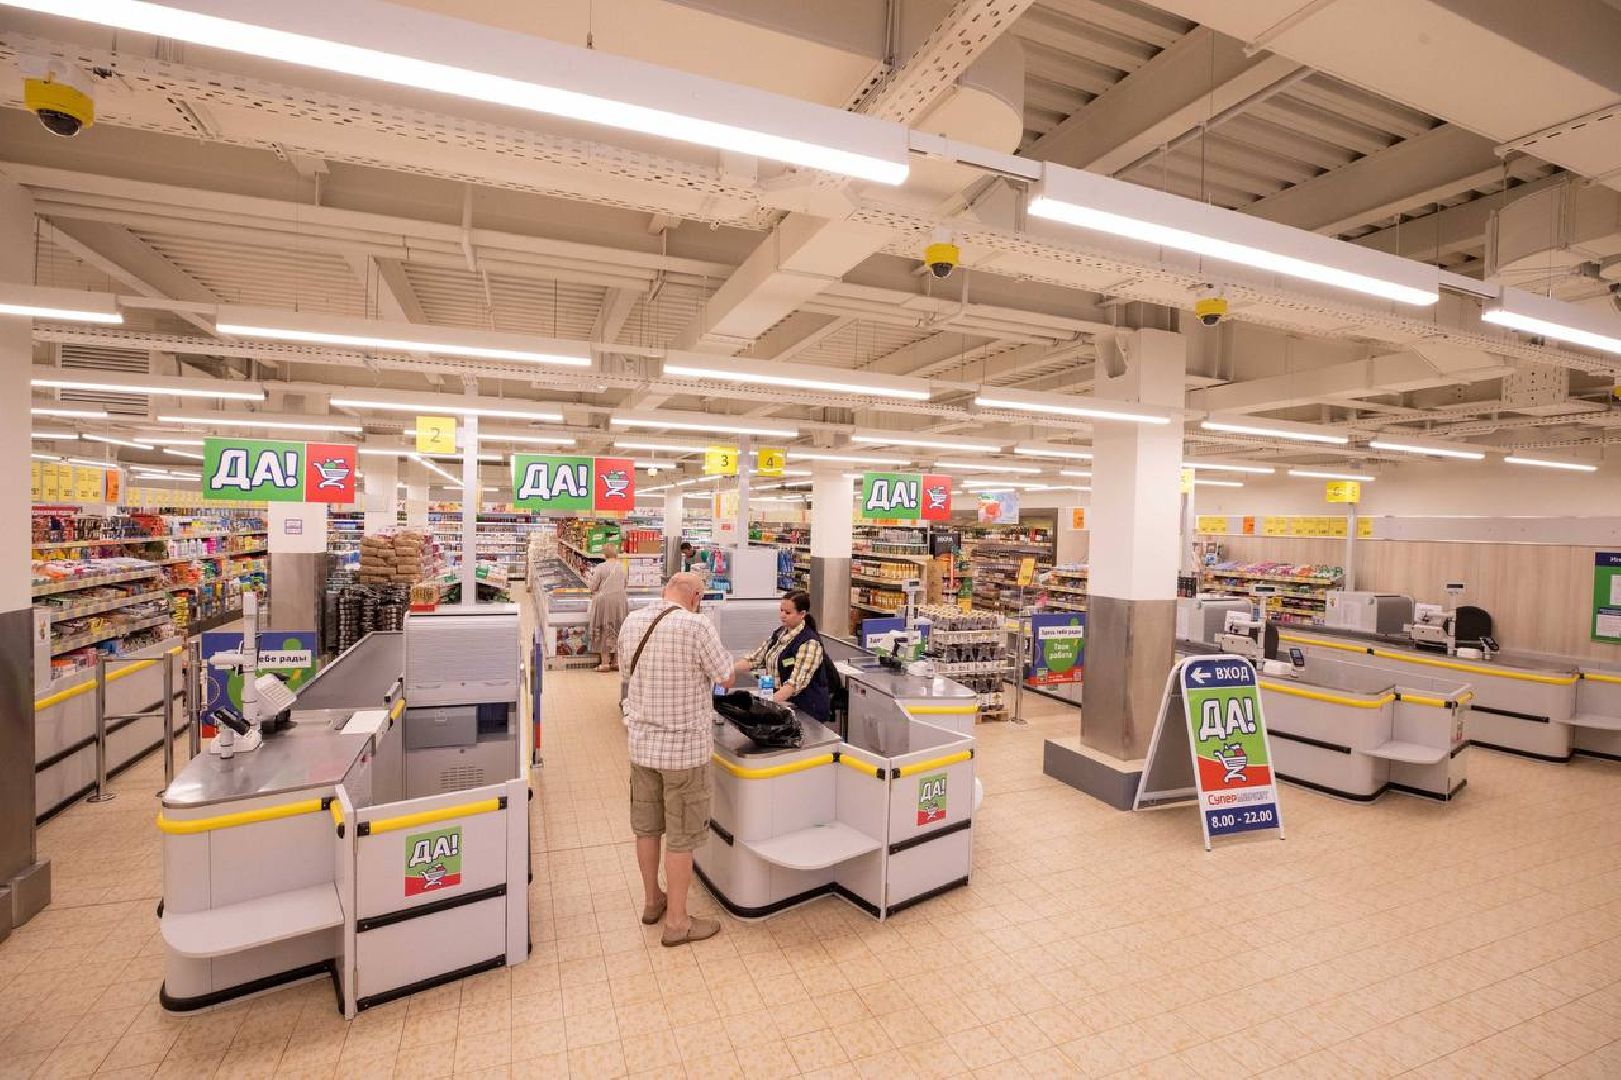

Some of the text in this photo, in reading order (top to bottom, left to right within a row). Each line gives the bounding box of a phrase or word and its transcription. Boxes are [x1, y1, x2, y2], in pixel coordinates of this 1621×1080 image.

[430, 427, 442, 443] 2
[210, 449, 298, 491] ДА!
[721, 454, 729, 467] 3
[766, 457, 774, 469] 4
[517, 463, 588, 501] ДА!
[866, 478, 918, 511] ДА!
[258, 654, 307, 664] ебе рады
[1215, 667, 1250, 682] ВХОД
[1199, 696, 1257, 741] ДА!
[920, 778, 945, 803] ДА!
[1212, 814, 1235, 828] 8.00
[1244, 810, 1272, 824] 22.00
[409, 833, 459, 868] ДА!
